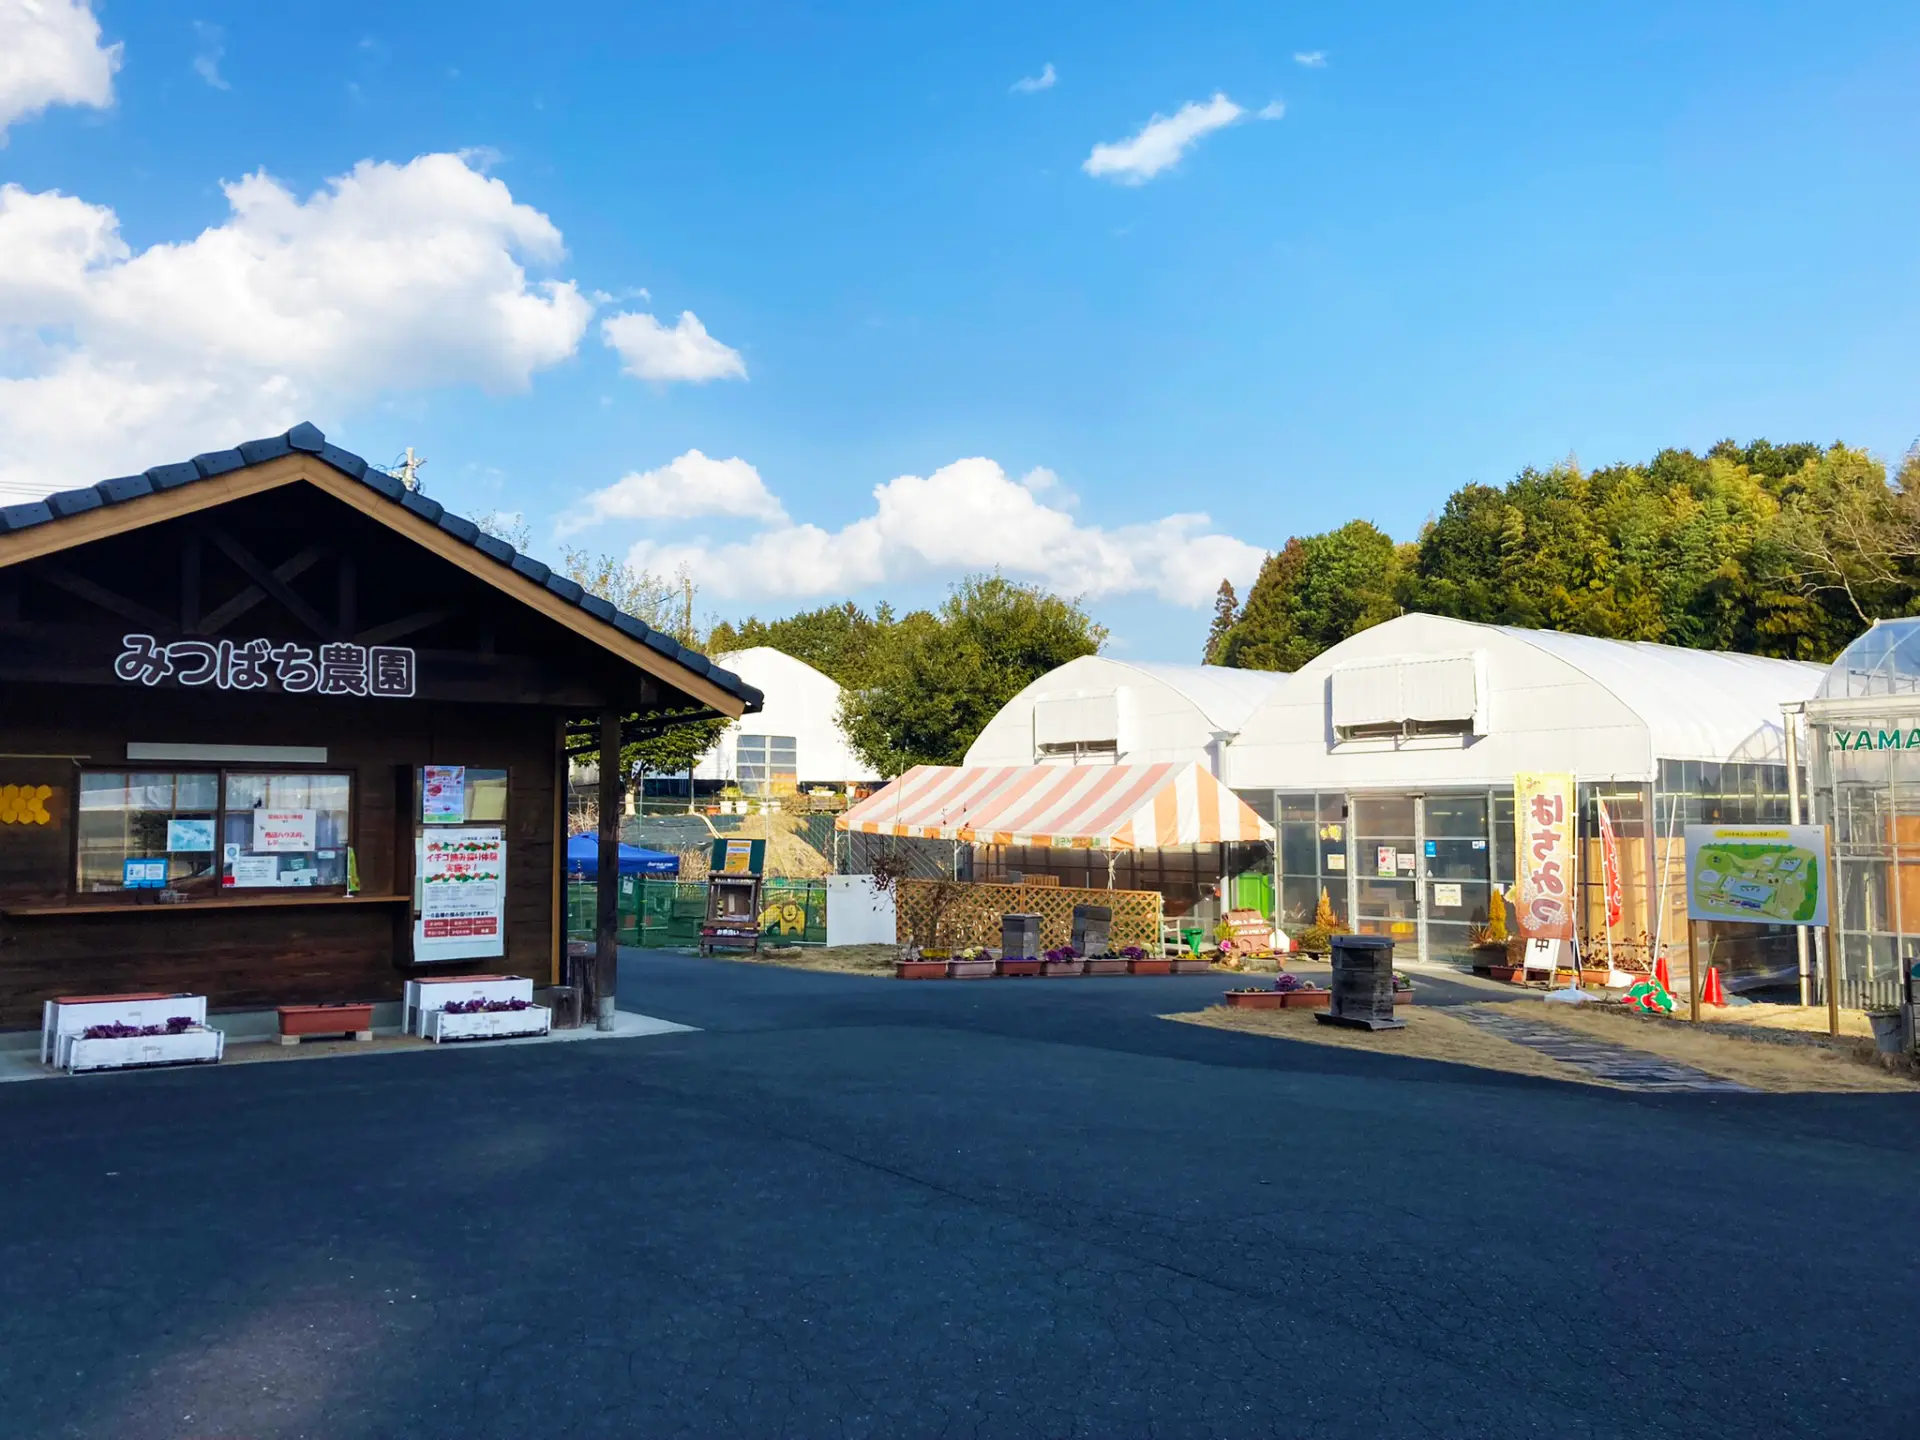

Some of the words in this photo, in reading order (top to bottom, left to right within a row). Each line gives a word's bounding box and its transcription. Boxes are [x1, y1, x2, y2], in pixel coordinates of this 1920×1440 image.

[114, 634, 416, 697] みつばち農園
[1834, 728, 1920, 751] YAMA
